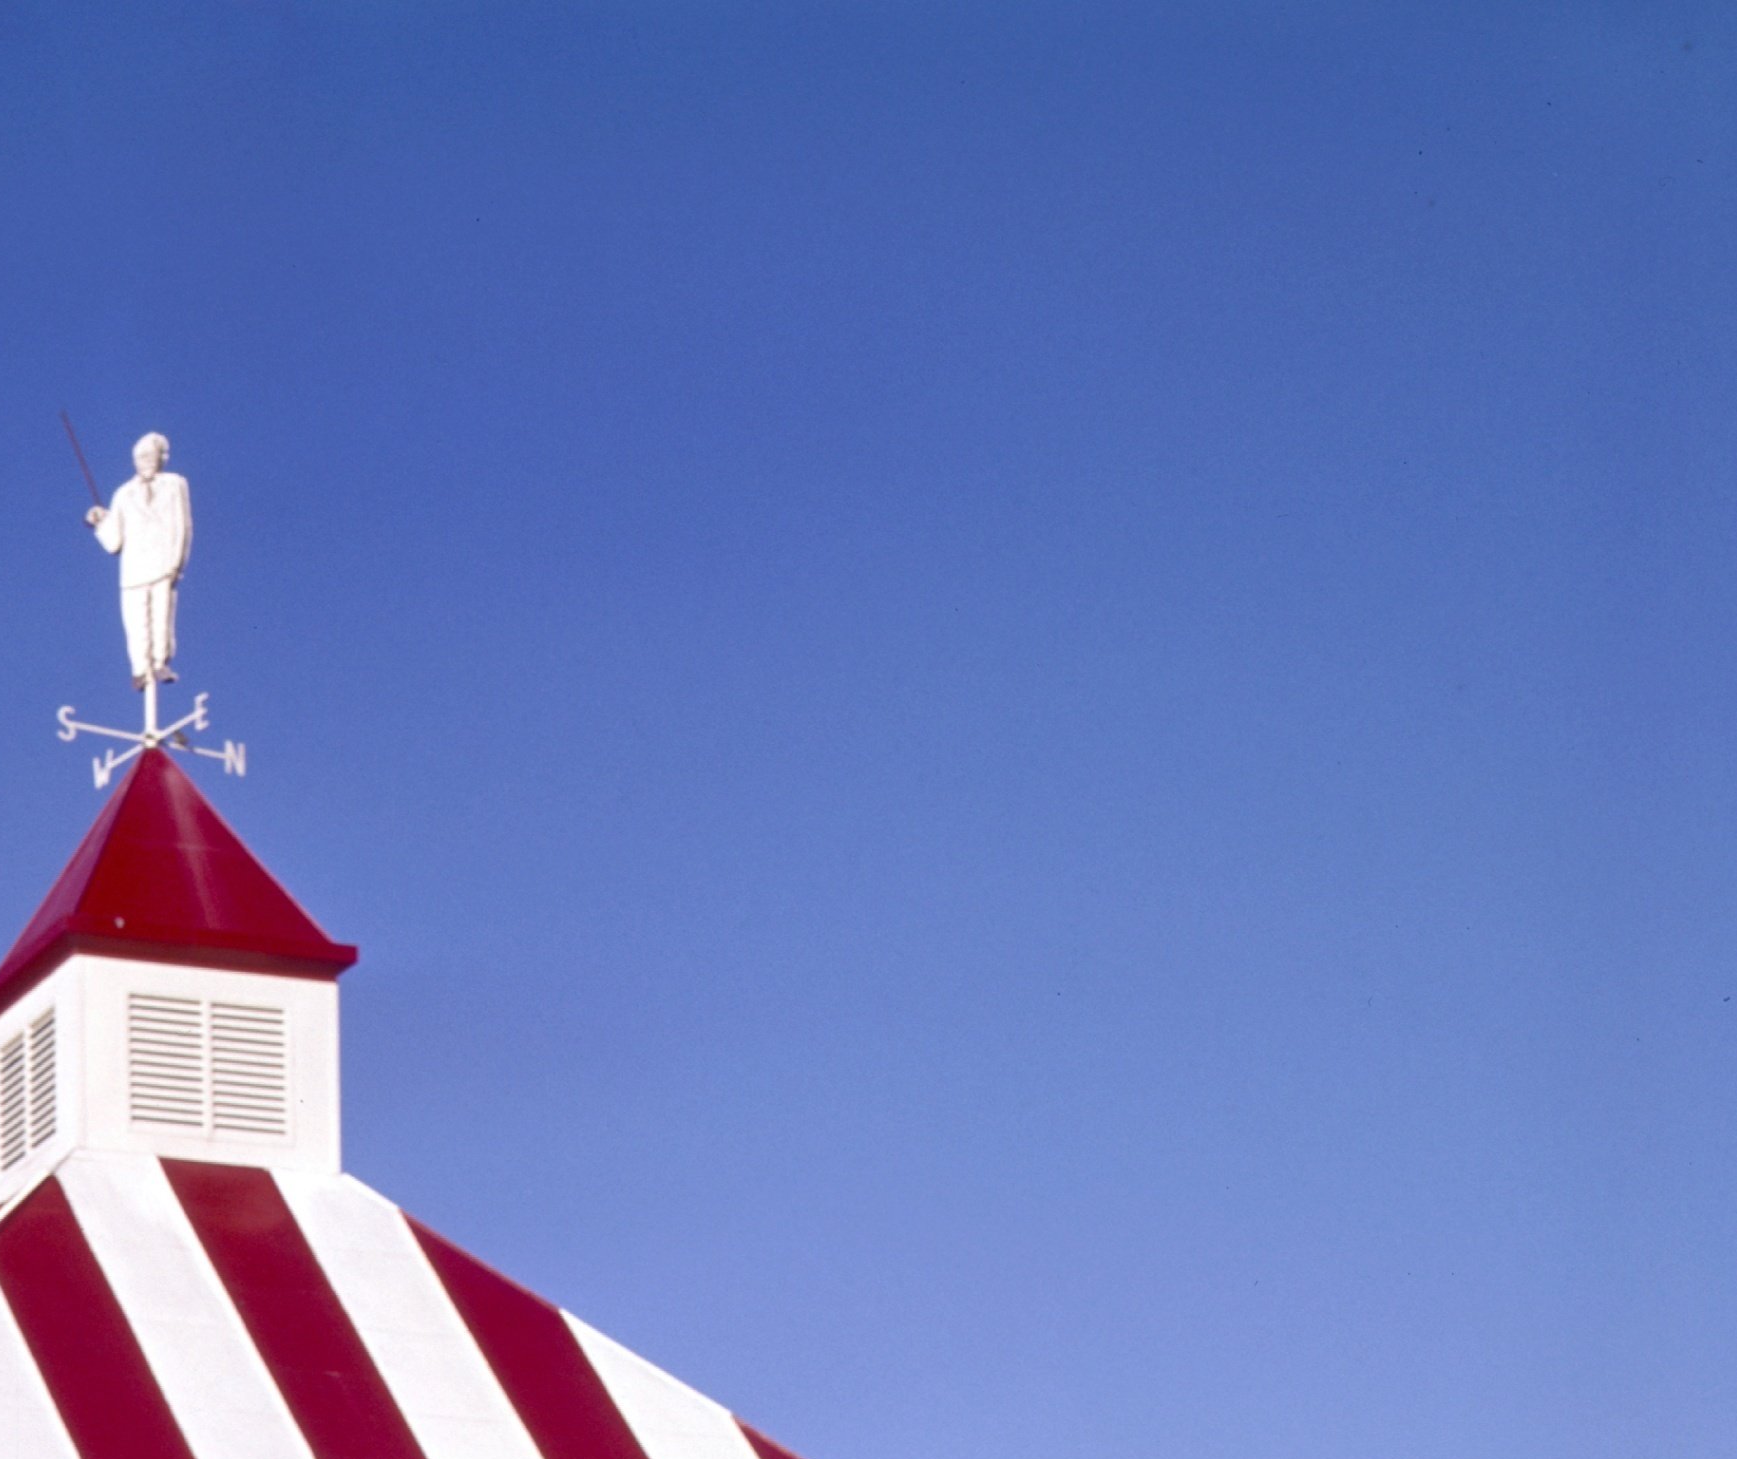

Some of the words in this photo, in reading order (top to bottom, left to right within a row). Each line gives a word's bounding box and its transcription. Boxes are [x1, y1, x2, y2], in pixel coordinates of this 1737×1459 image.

[56, 706, 76, 742] S
[194, 693, 209, 731] E
[93, 749, 114, 790] W
[225, 739, 246, 777] N
